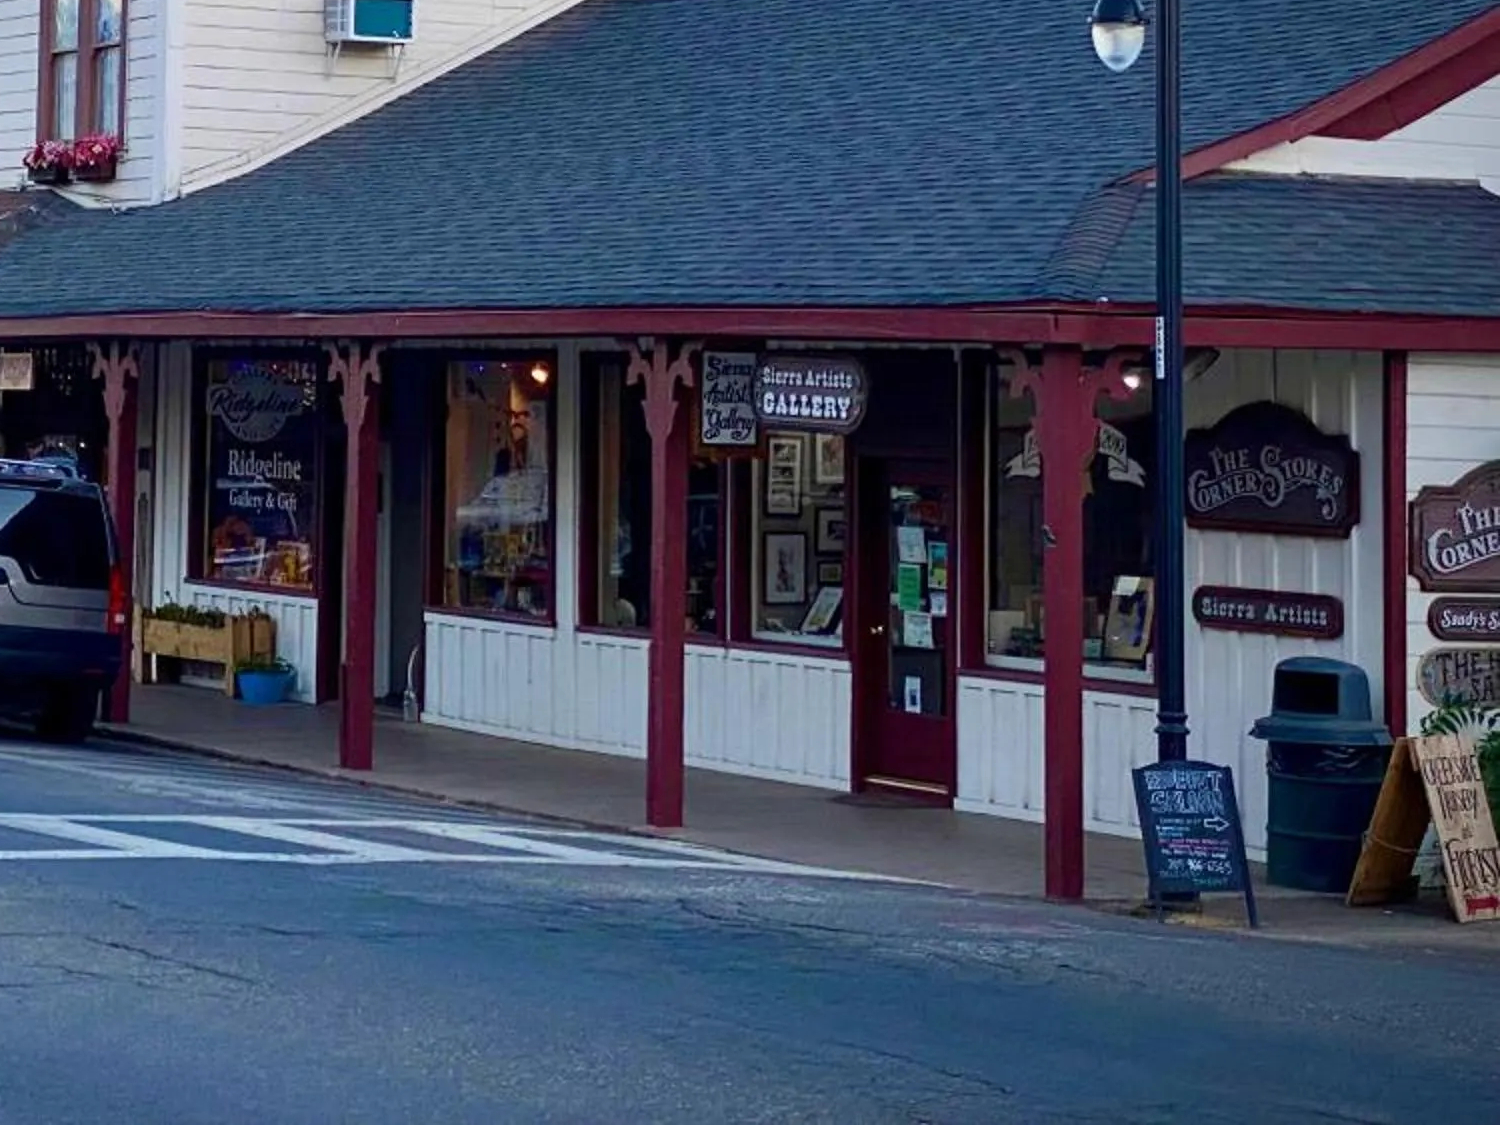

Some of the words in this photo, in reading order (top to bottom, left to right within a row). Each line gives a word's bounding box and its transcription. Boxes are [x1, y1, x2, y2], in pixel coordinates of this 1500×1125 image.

[762, 366, 802, 386] Sierra
[805, 370, 852, 388] Artists
[763, 392, 851, 419] GALLERY
[228, 449, 301, 484] Ridgeline
[1208, 447, 1250, 476] THE
[1188, 469, 1259, 512] CORNER
[1260, 445, 1344, 520] STORES
[229, 488, 265, 514] Gallery
[265, 492, 275, 508] &
[1456, 501, 1500, 535] THE
[1428, 528, 1500, 573] CORNE
[1201, 596, 1255, 619] Sierra
[1265, 601, 1329, 626] Artists
[1441, 609, 1486, 630] Sandy's
[1487, 611, 1500, 629] S
[1436, 650, 1482, 687] THE
